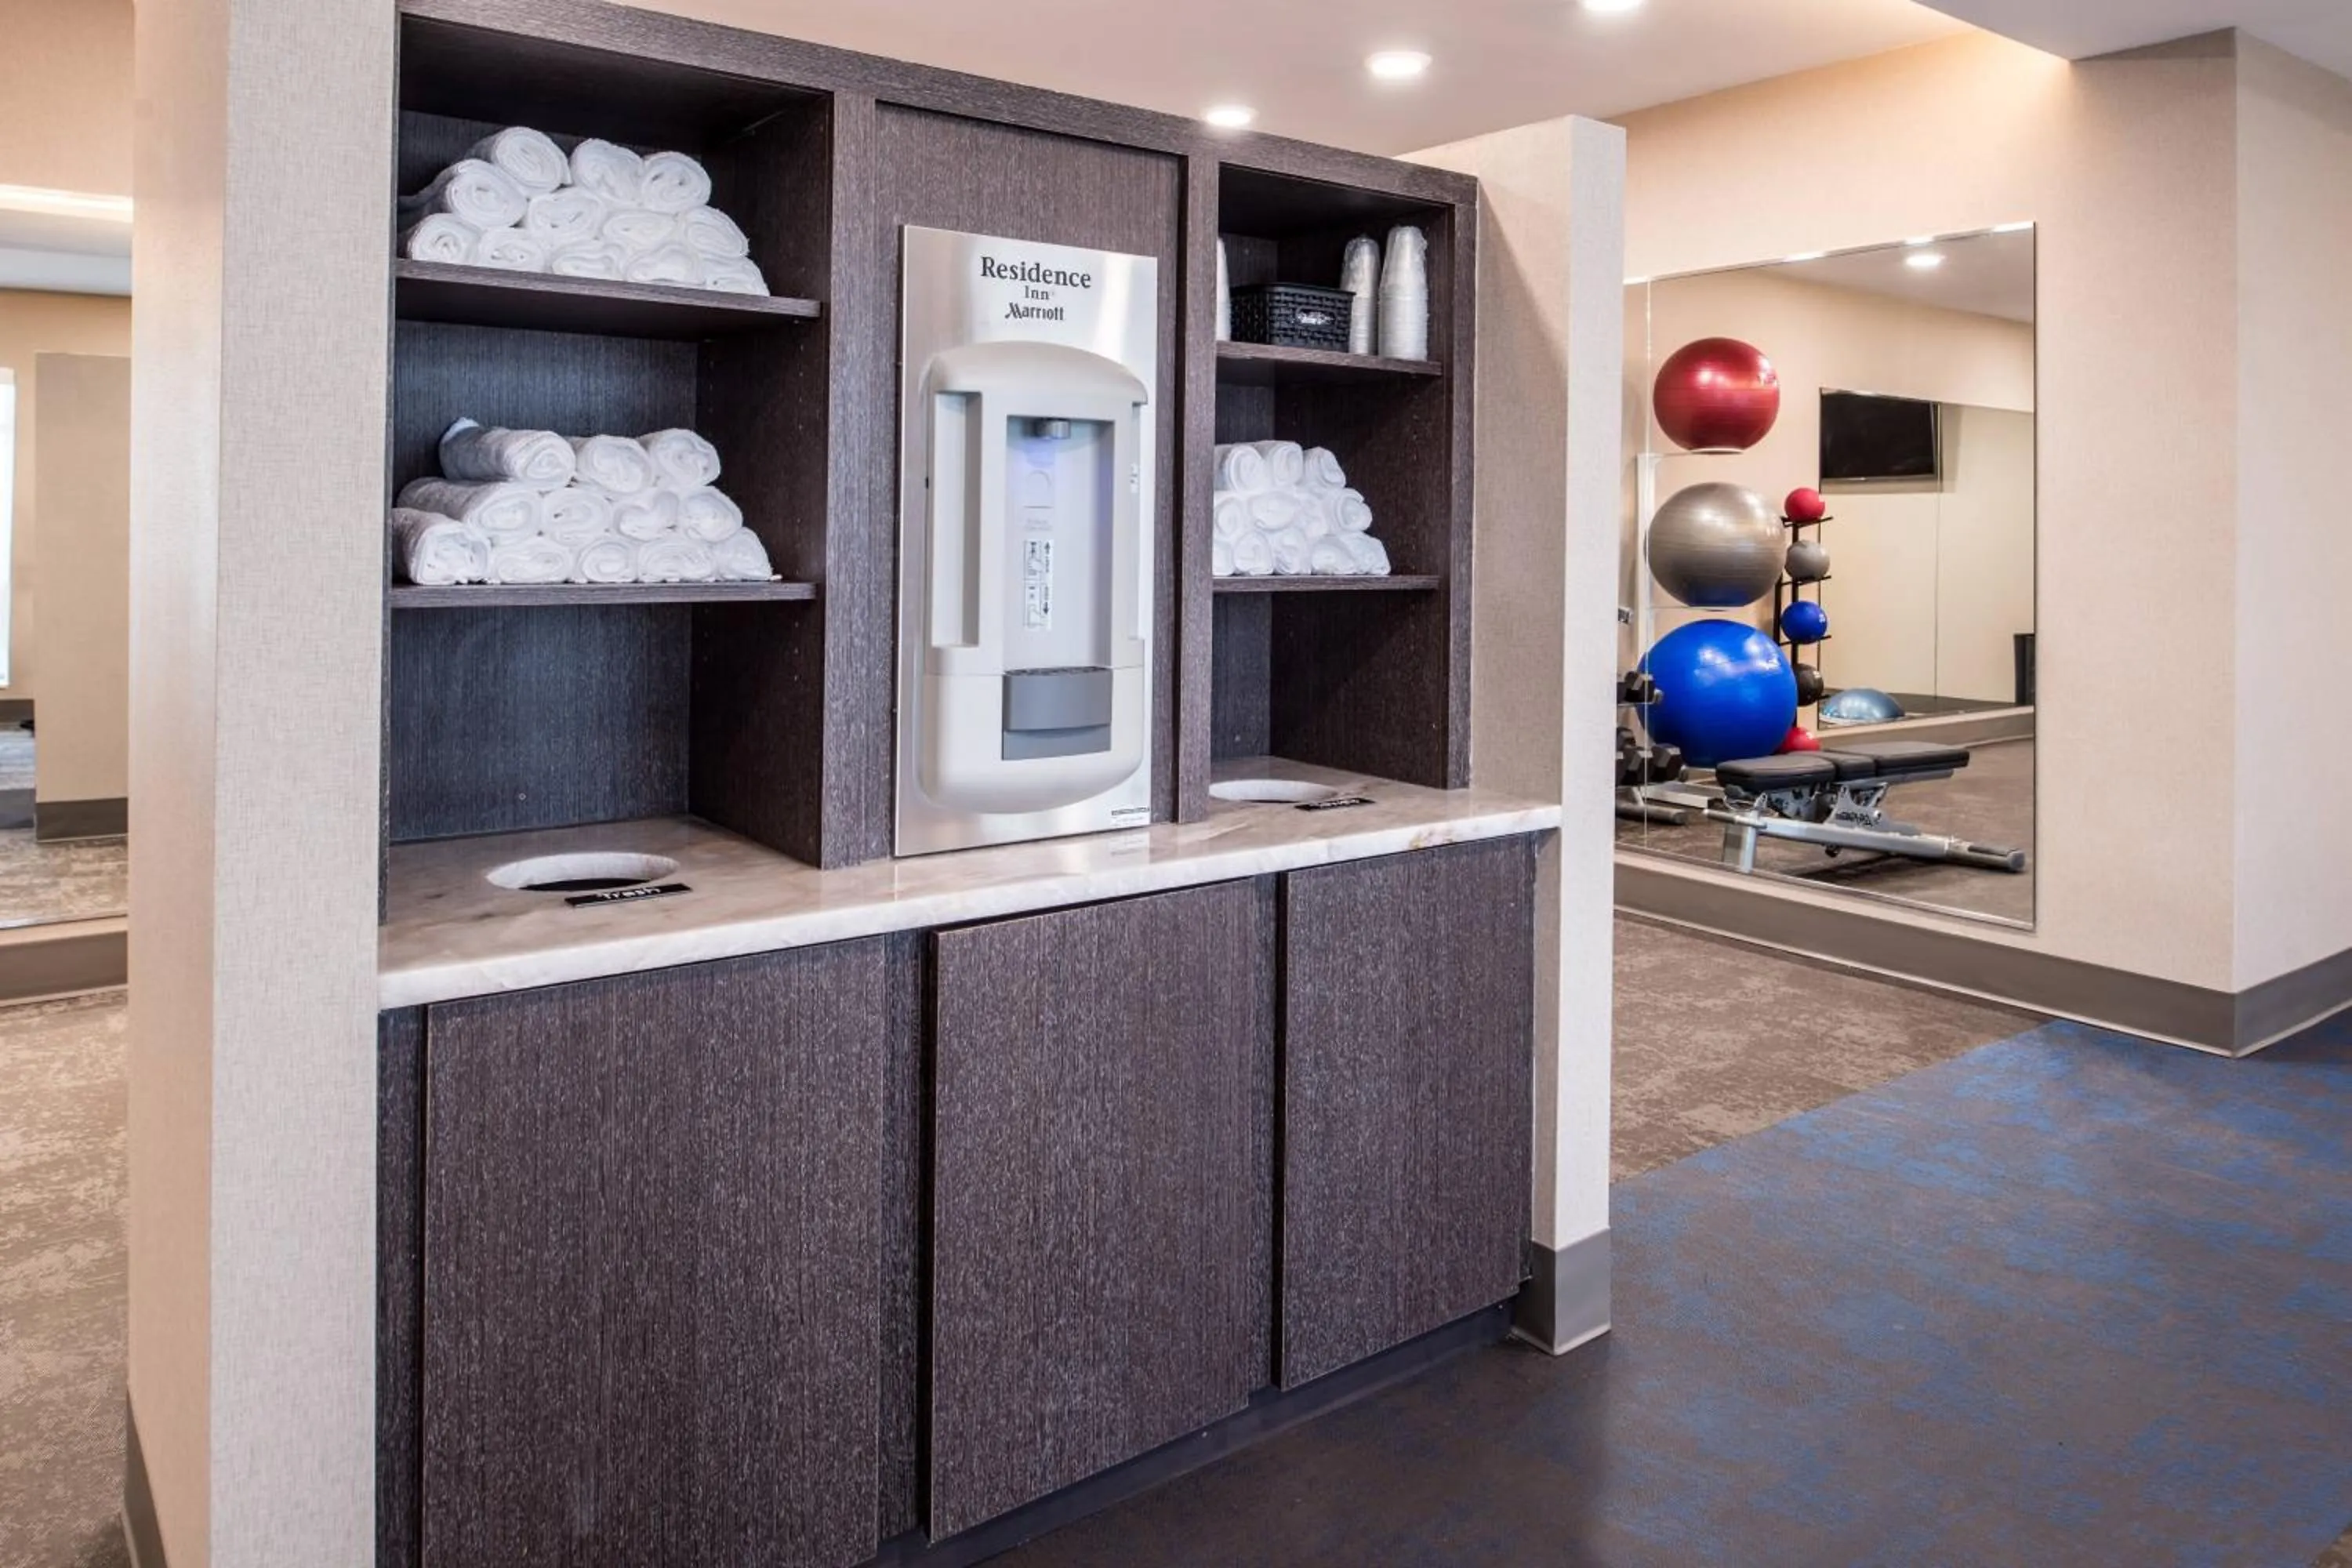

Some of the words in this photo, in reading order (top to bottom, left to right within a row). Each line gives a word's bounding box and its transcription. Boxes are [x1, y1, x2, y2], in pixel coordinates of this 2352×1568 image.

[981, 256, 1091, 289] Residence
[1025, 285, 1049, 300] Inn
[1004, 302, 1064, 321] Marriott
